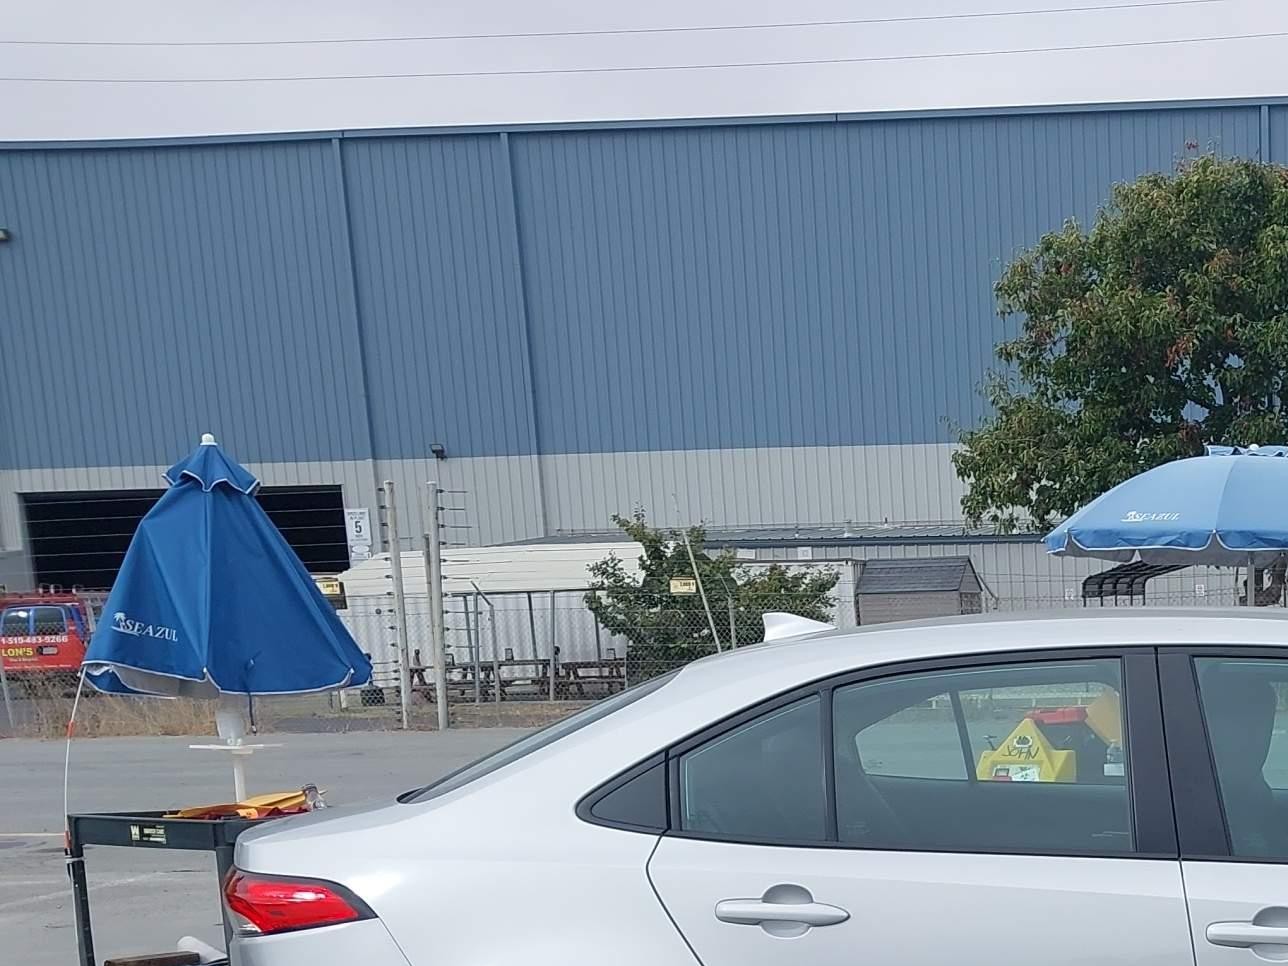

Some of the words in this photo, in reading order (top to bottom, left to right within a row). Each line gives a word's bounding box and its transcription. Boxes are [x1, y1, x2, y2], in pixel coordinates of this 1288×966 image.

[354, 520, 363, 534] 5
[126, 619, 179, 642] SEAZUL
[1002, 744, 1040, 760] JOHN
